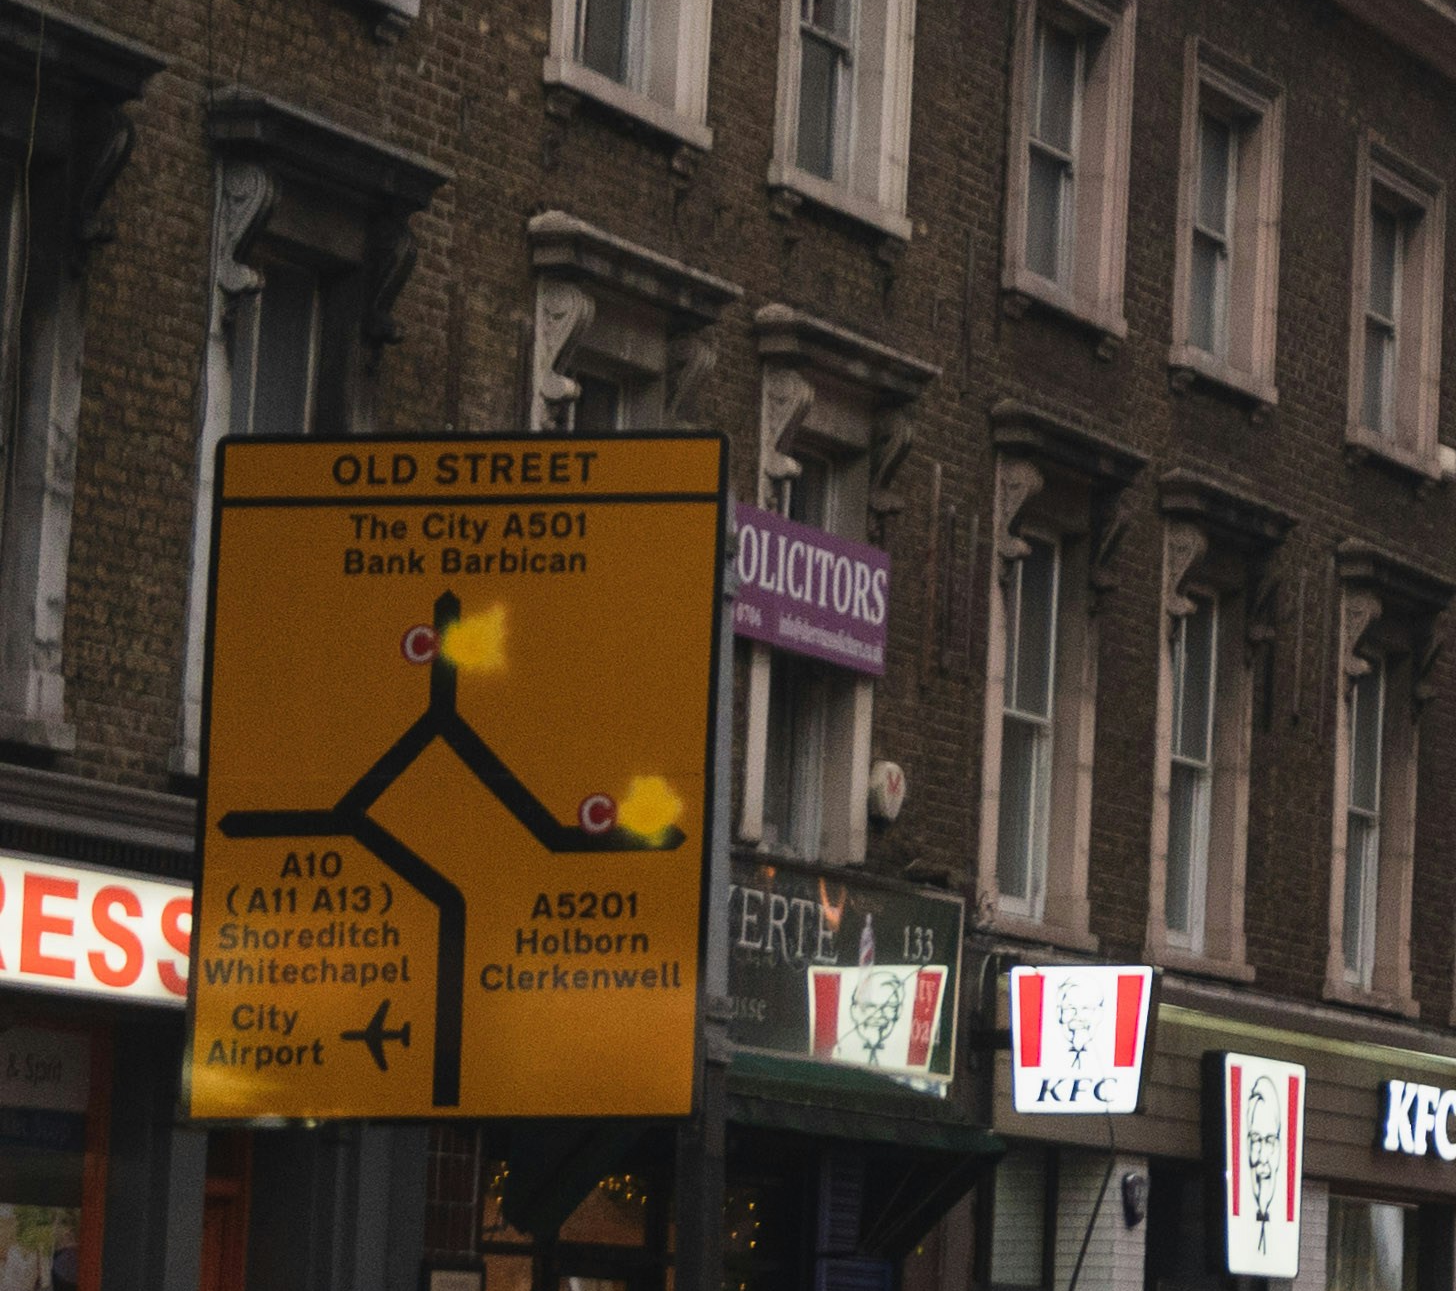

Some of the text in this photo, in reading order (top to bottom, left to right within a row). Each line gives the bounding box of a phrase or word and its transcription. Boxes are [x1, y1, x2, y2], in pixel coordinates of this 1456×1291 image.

[332, 451, 598, 486] OLD STREET
[350, 512, 588, 544] The City A501
[344, 547, 587, 575] Bank Barbican
[738, 524, 887, 626] OLICITORS
[281, 852, 342, 878] A10
[531, 892, 637, 920] A5201
[0, 871, 193, 997] ESS
[218, 921, 399, 951] Shoreditch
[515, 928, 648, 956] Holborn
[903, 925, 934, 961] 133
[204, 956, 411, 986] Whitechapel
[480, 962, 681, 991] Clerkenwell
[232, 1004, 298, 1035] City
[206, 1040, 324, 1072] Airport
[1036, 1078, 1118, 1103] KFC
